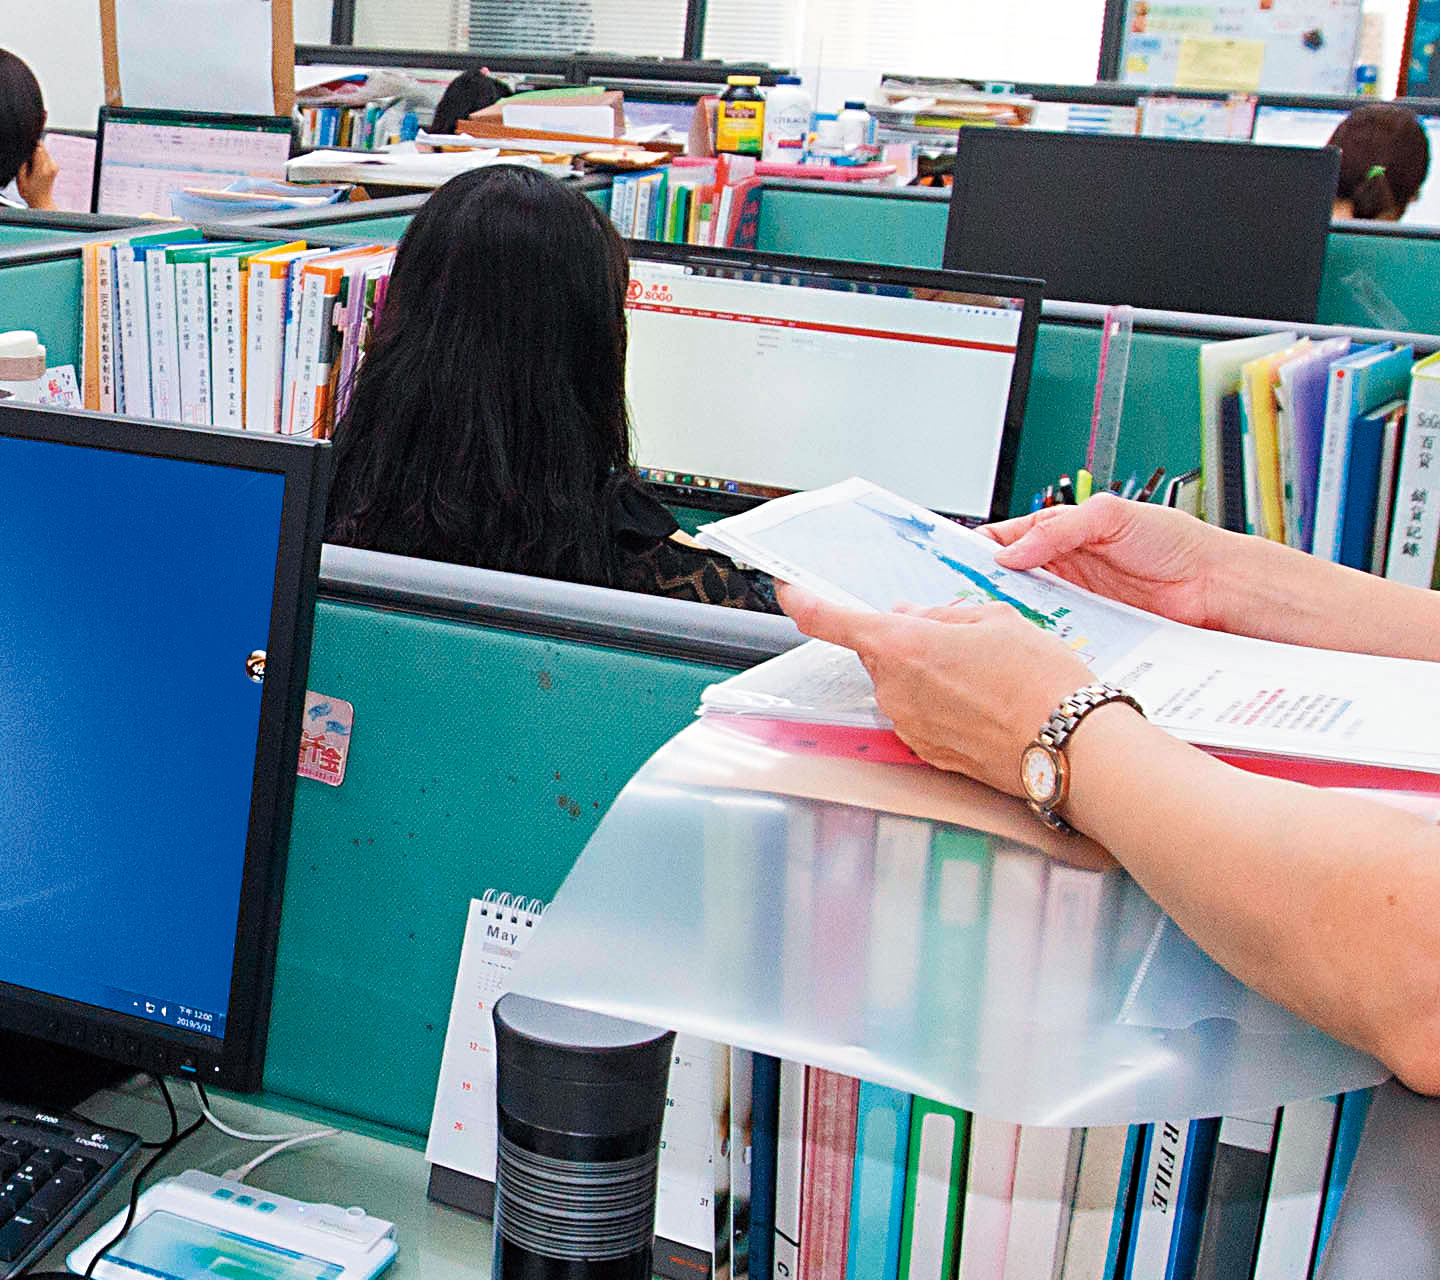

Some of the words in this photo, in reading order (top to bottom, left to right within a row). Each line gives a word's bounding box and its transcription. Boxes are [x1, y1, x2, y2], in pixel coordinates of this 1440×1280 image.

[644, 291, 674, 303] SOGO
[485, 924, 520, 946] May
[469, 1041, 479, 1051] 12
[35, 1113, 59, 1125] K200
[74, 1136, 110, 1152] Logitech
[1150, 1149, 1178, 1217] FILE
[698, 1196, 710, 1208] 31
